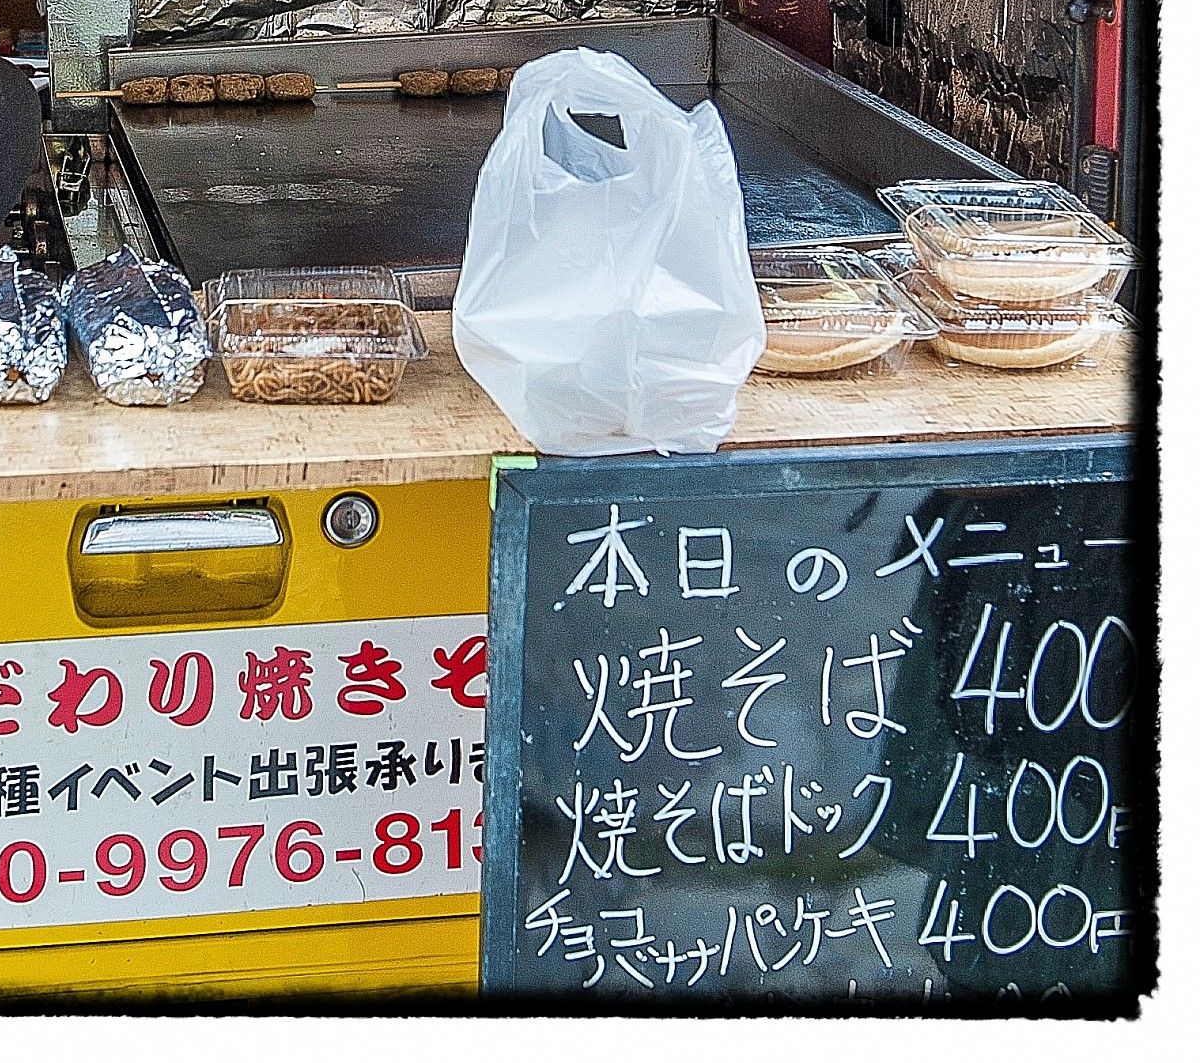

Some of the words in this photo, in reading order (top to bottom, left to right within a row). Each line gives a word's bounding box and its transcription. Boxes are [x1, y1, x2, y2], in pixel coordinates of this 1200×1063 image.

[572, 618, 923, 763] 焼そば
[950, 603, 1138, 734] 400
